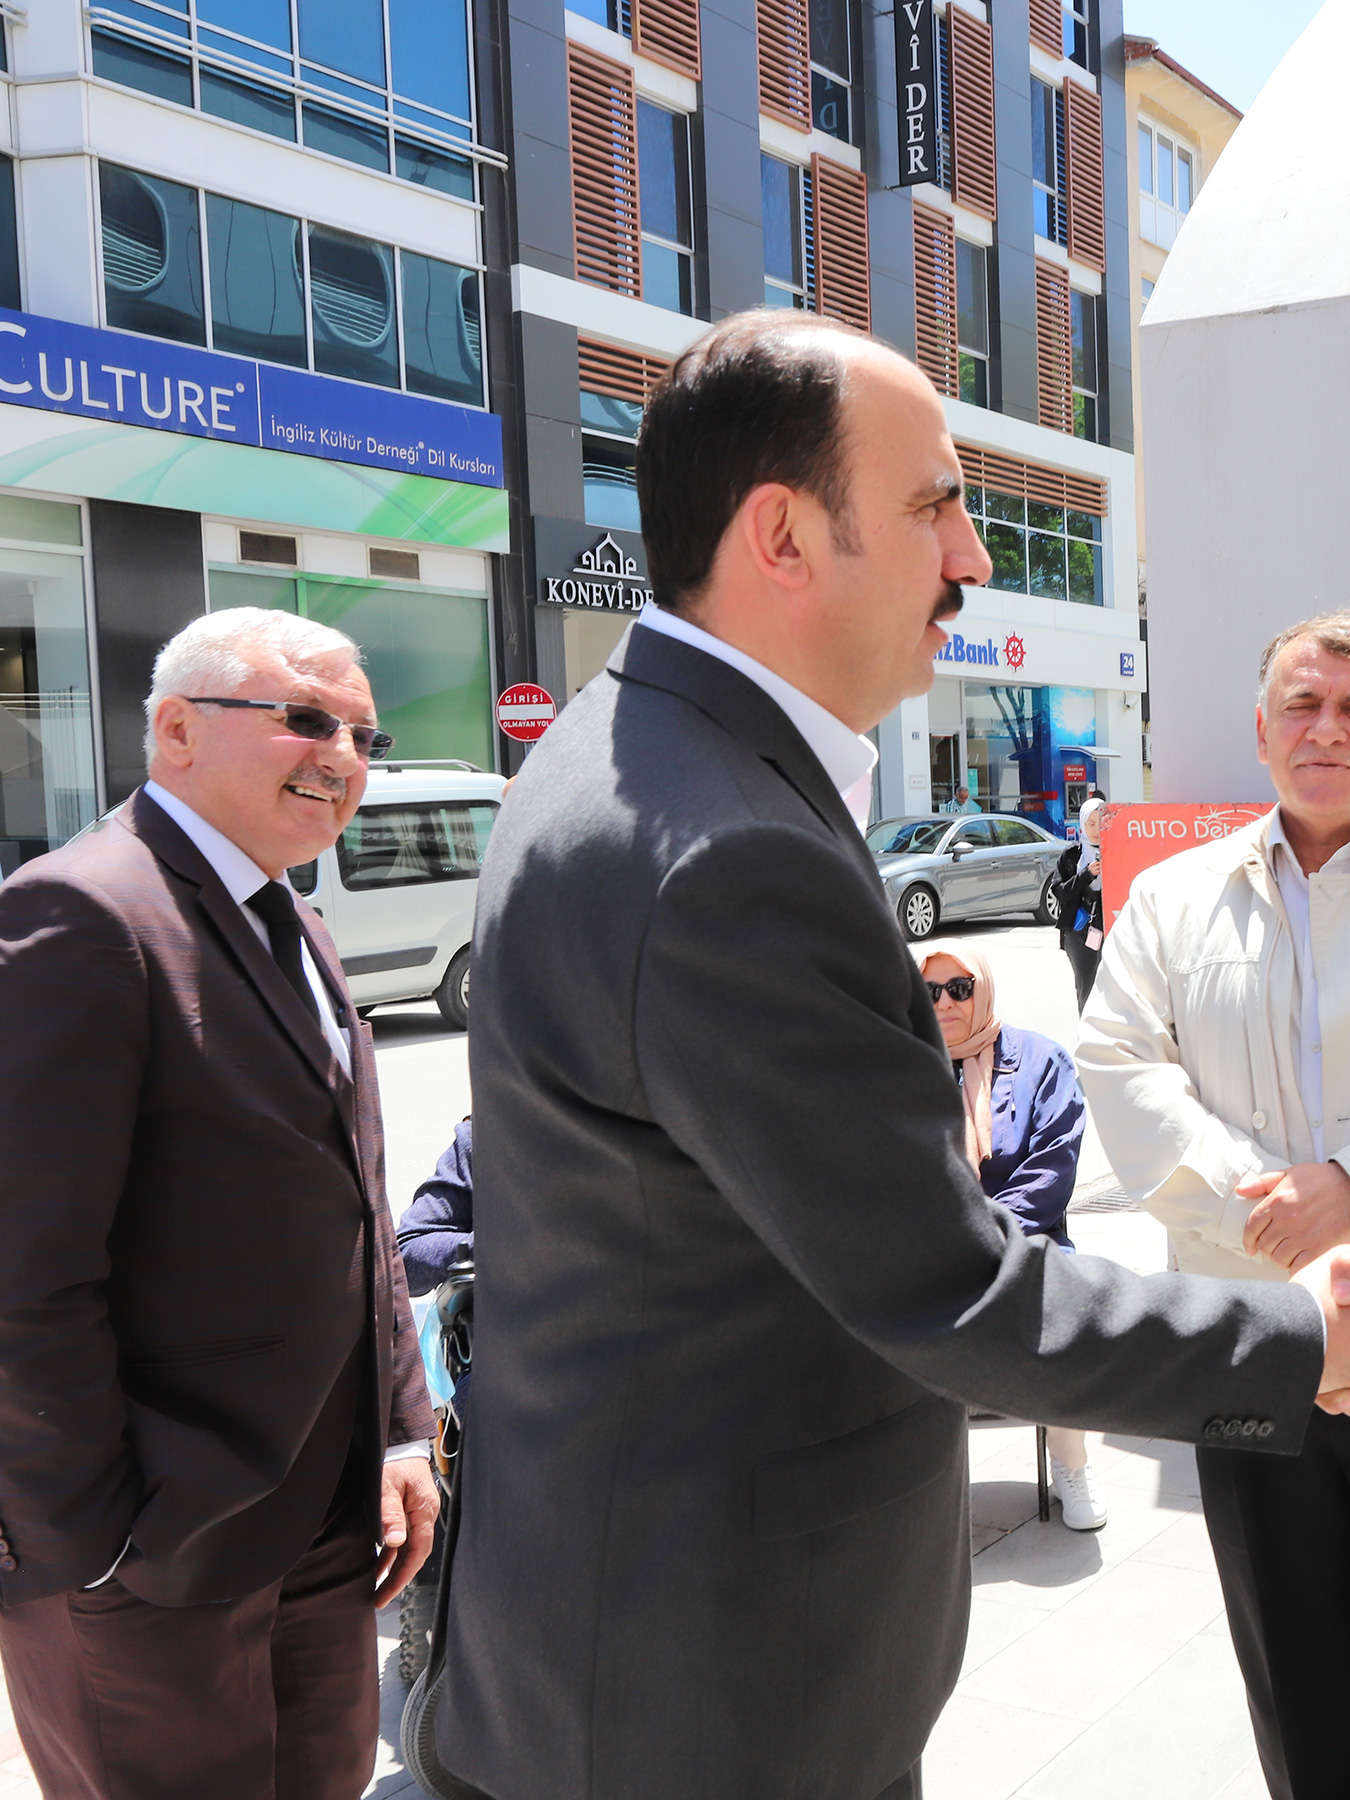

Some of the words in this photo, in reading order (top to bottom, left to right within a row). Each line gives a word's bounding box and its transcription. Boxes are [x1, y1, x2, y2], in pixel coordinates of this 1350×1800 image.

[905, 82, 929, 175] DER
[271, 414, 315, 444] İngiliz
[320, 428, 362, 451] Kültür
[428, 449, 445, 467] Dil
[450, 453, 495, 476] Kursları
[1123, 655, 1133, 669] 24
[505, 692, 543, 704] GİRİŞİ
[503, 720, 536, 728] OLMAYAN
[1127, 820, 1187, 838] AUTO
